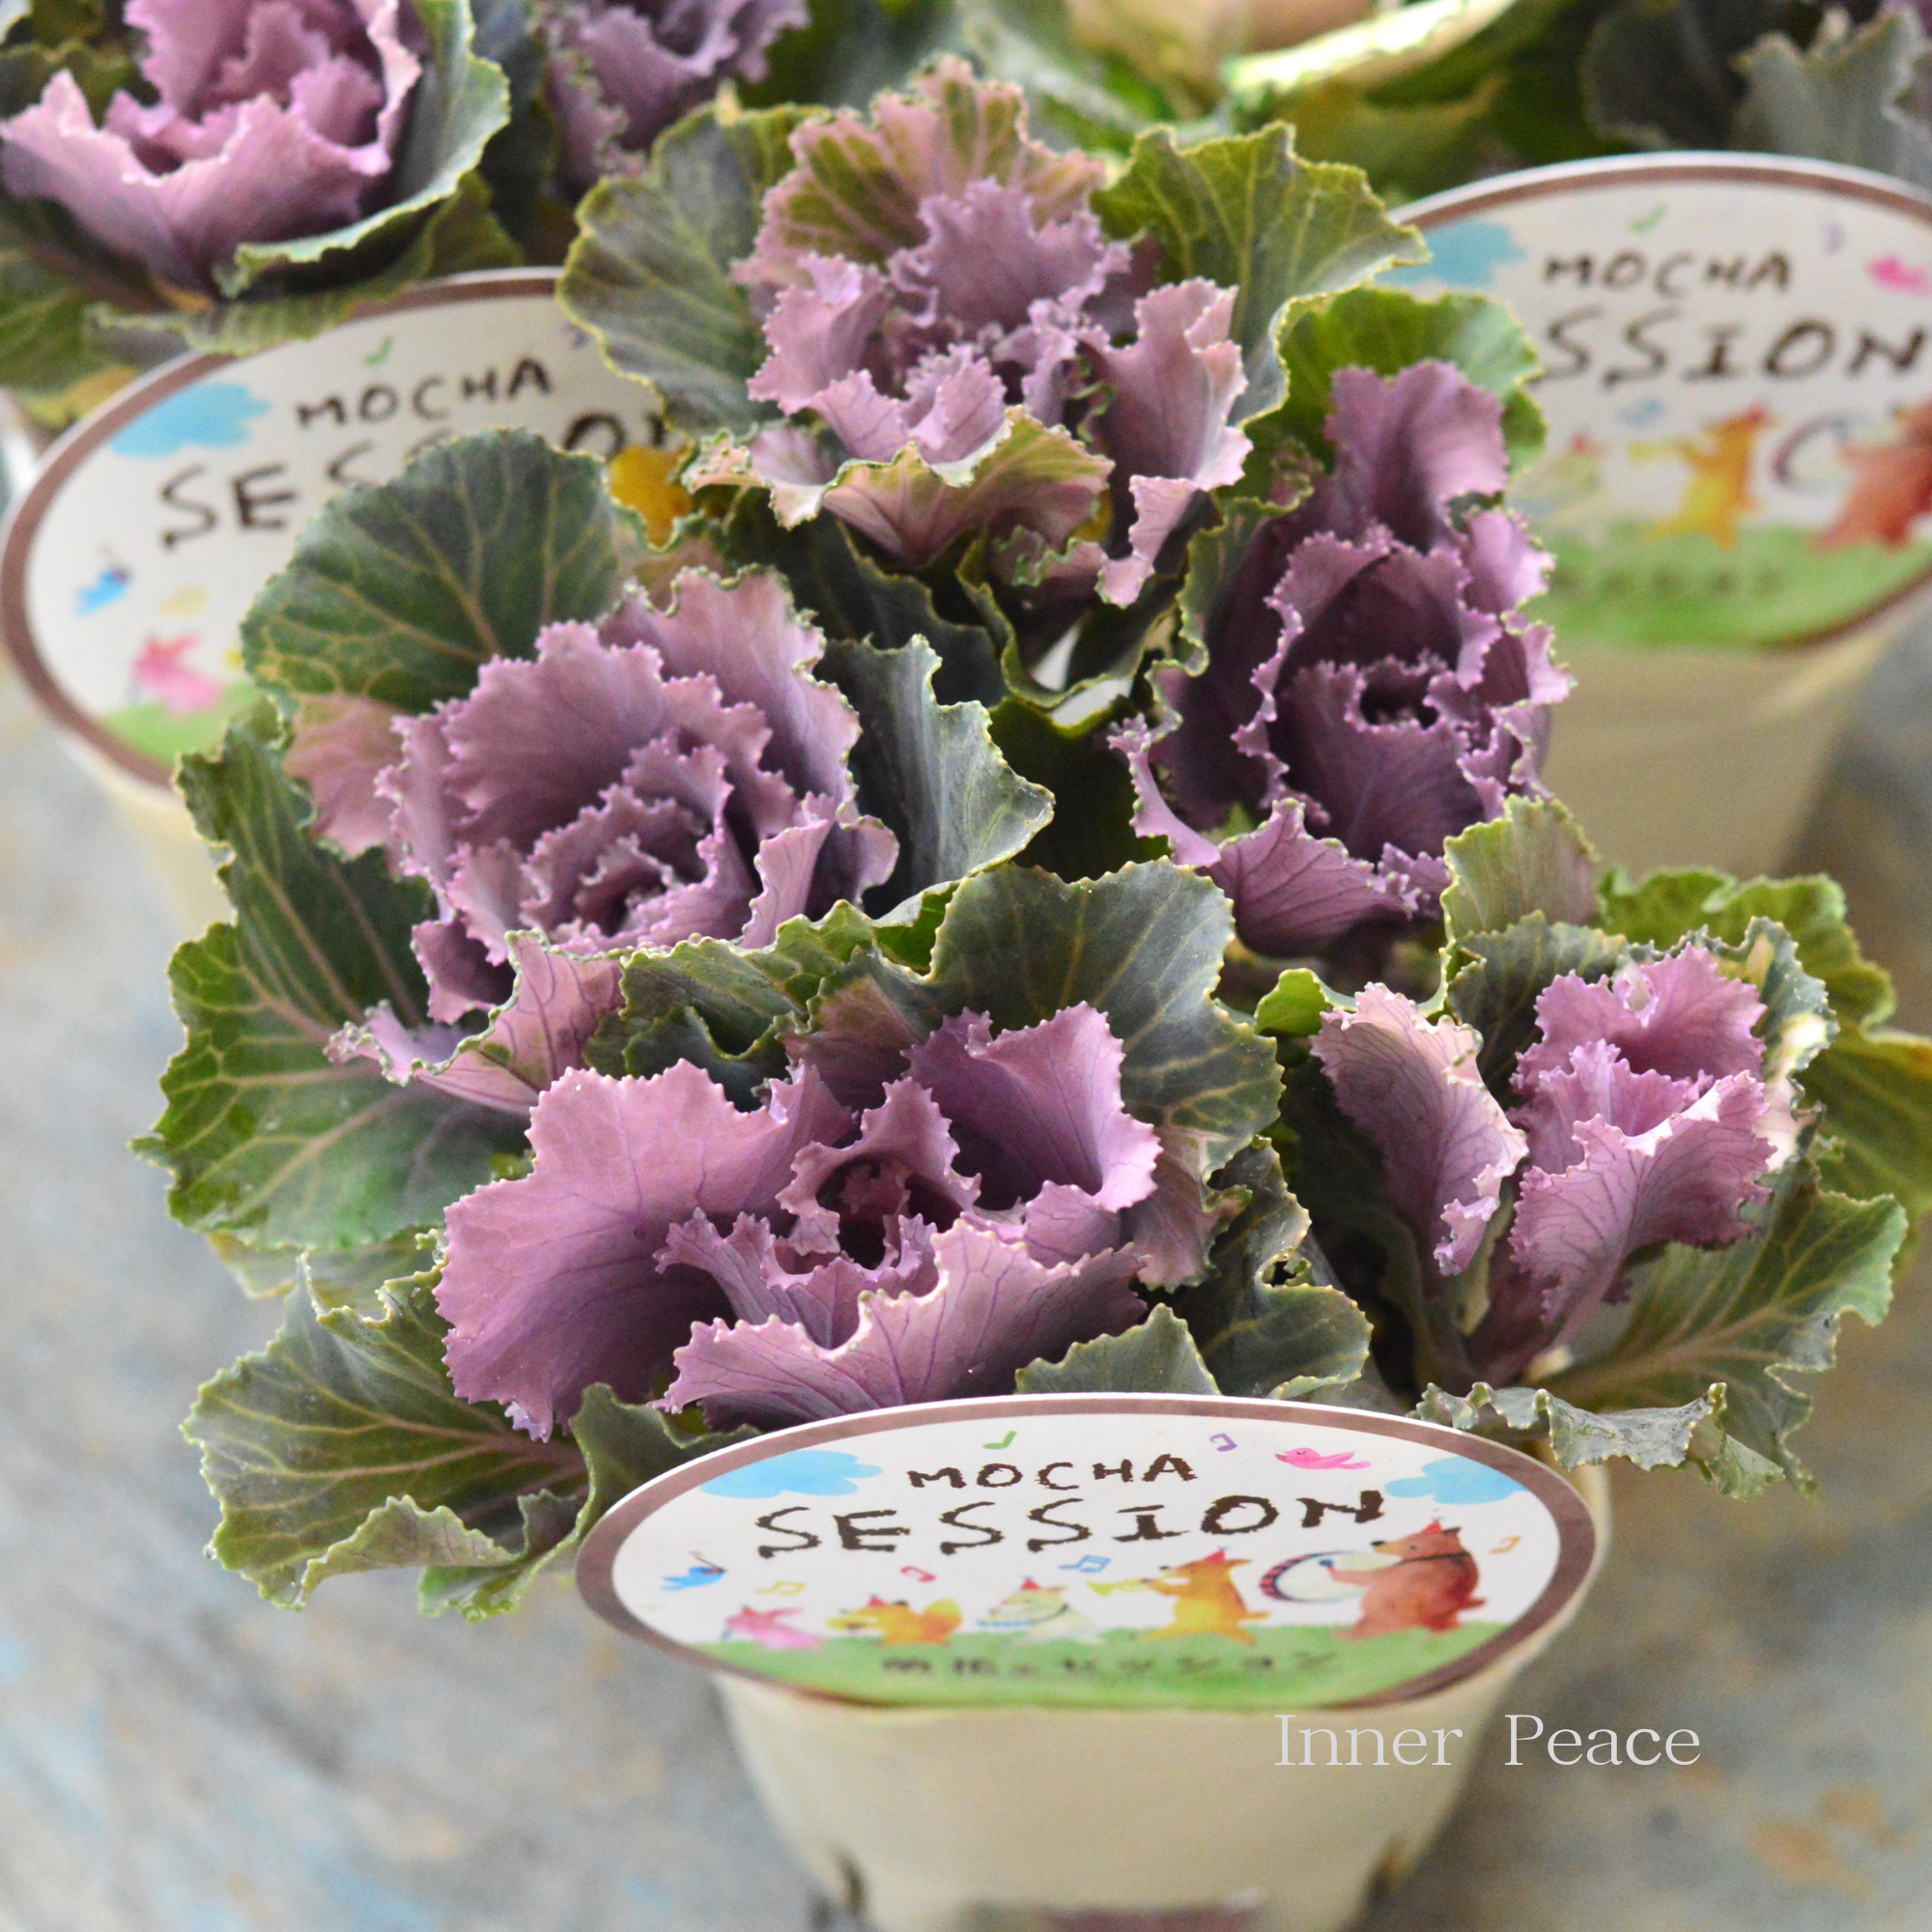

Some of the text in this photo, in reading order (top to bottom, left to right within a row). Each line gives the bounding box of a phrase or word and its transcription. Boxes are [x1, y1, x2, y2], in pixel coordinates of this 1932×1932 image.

[1544, 251, 1792, 298] MOCHA
[1524, 304, 1928, 388] SSION
[297, 357, 553, 427] MOCHA
[907, 1453, 1199, 1491] MOCHA
[754, 1489, 1384, 1558] SESSION
